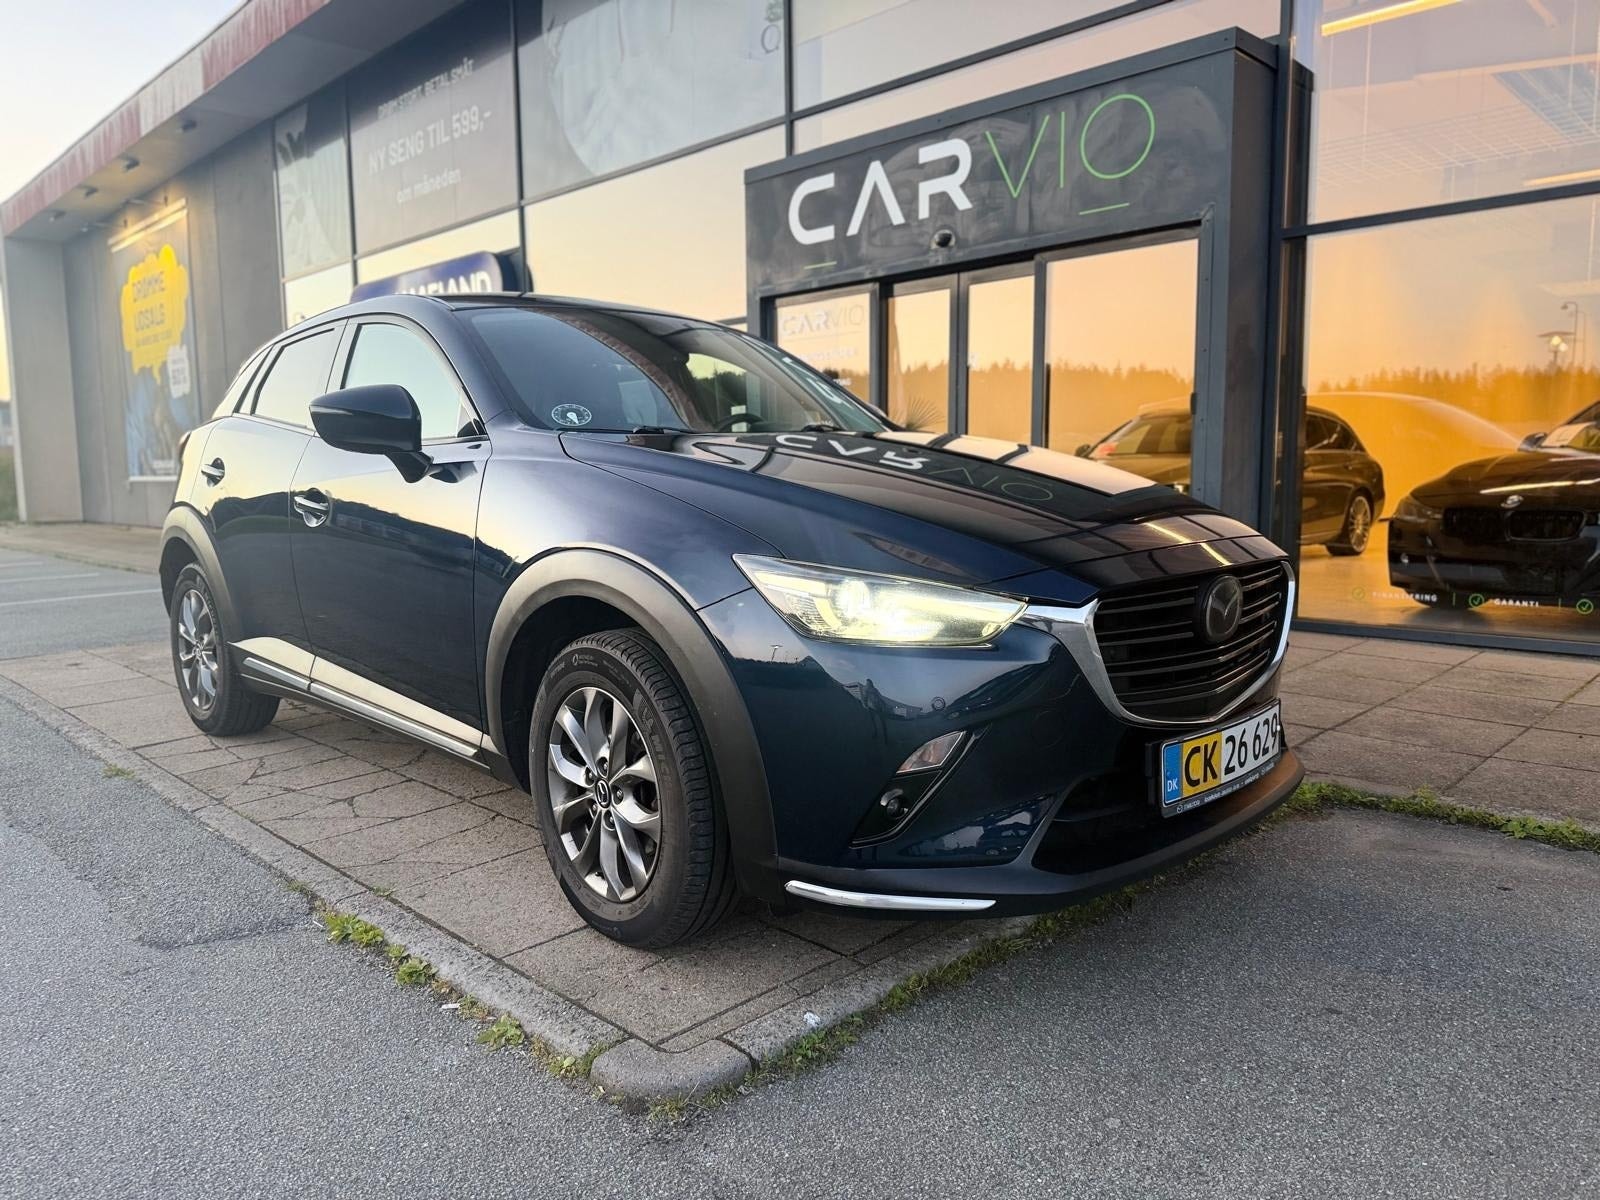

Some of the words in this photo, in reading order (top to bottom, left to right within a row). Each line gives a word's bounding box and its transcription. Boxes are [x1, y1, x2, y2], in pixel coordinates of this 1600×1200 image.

[369, 146, 387, 175] NY
[388, 130, 425, 166] SENG
[427, 118, 450, 149] TIL
[452, 104, 492, 139] 599,-
[1167, 777, 1178, 792] DK
[1184, 740, 1218, 788] CK
[1223, 727, 1248, 776] 26
[1252, 712, 1278, 762] 629
